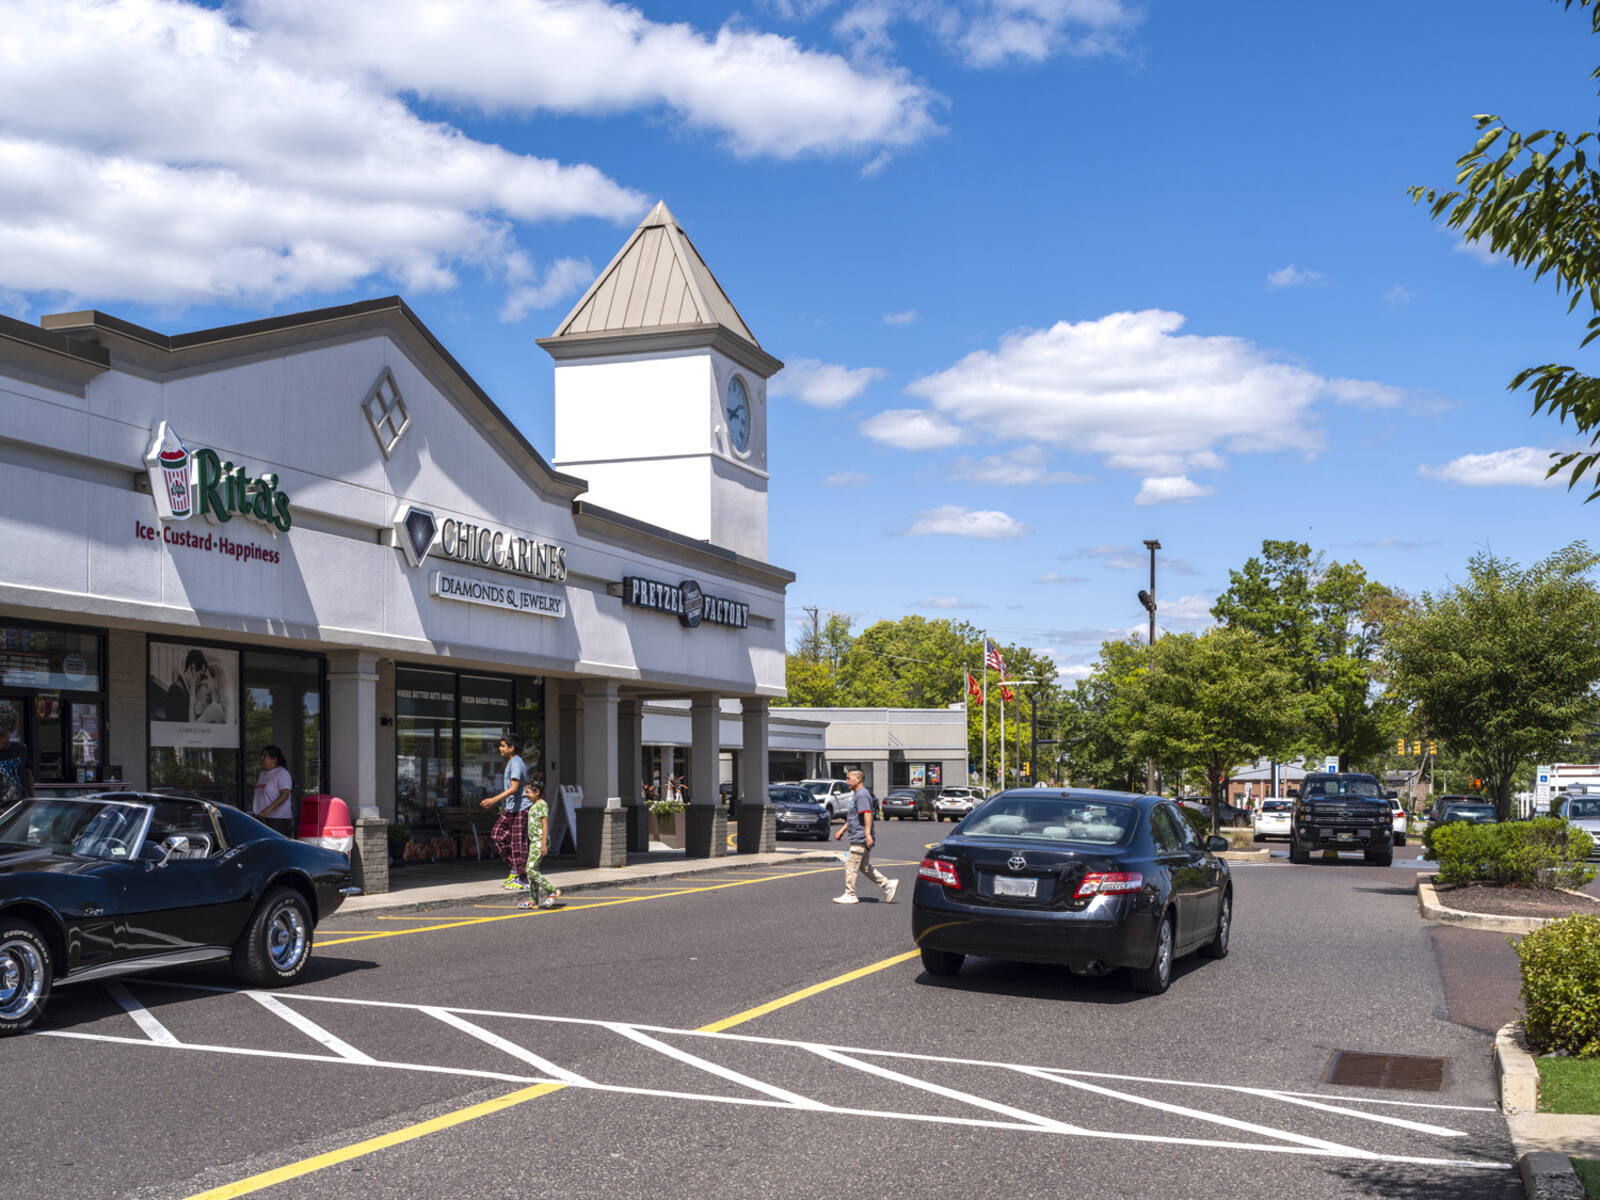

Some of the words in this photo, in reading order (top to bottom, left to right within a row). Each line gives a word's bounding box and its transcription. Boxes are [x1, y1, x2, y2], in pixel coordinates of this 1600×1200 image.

[194, 448, 292, 532] Rita's
[163, 525, 212, 551] Custard
[219, 536, 280, 564] Happiness
[442, 518, 567, 581] CHICCARINES
[441, 577, 504, 603] DIAMONDS
[506, 589, 518, 608] &
[520, 592, 561, 613] JEWELRY
[632, 578, 684, 613] PRETZEL
[704, 596, 748, 627] FACTORY
[4, 929, 33, 939] COOPER
